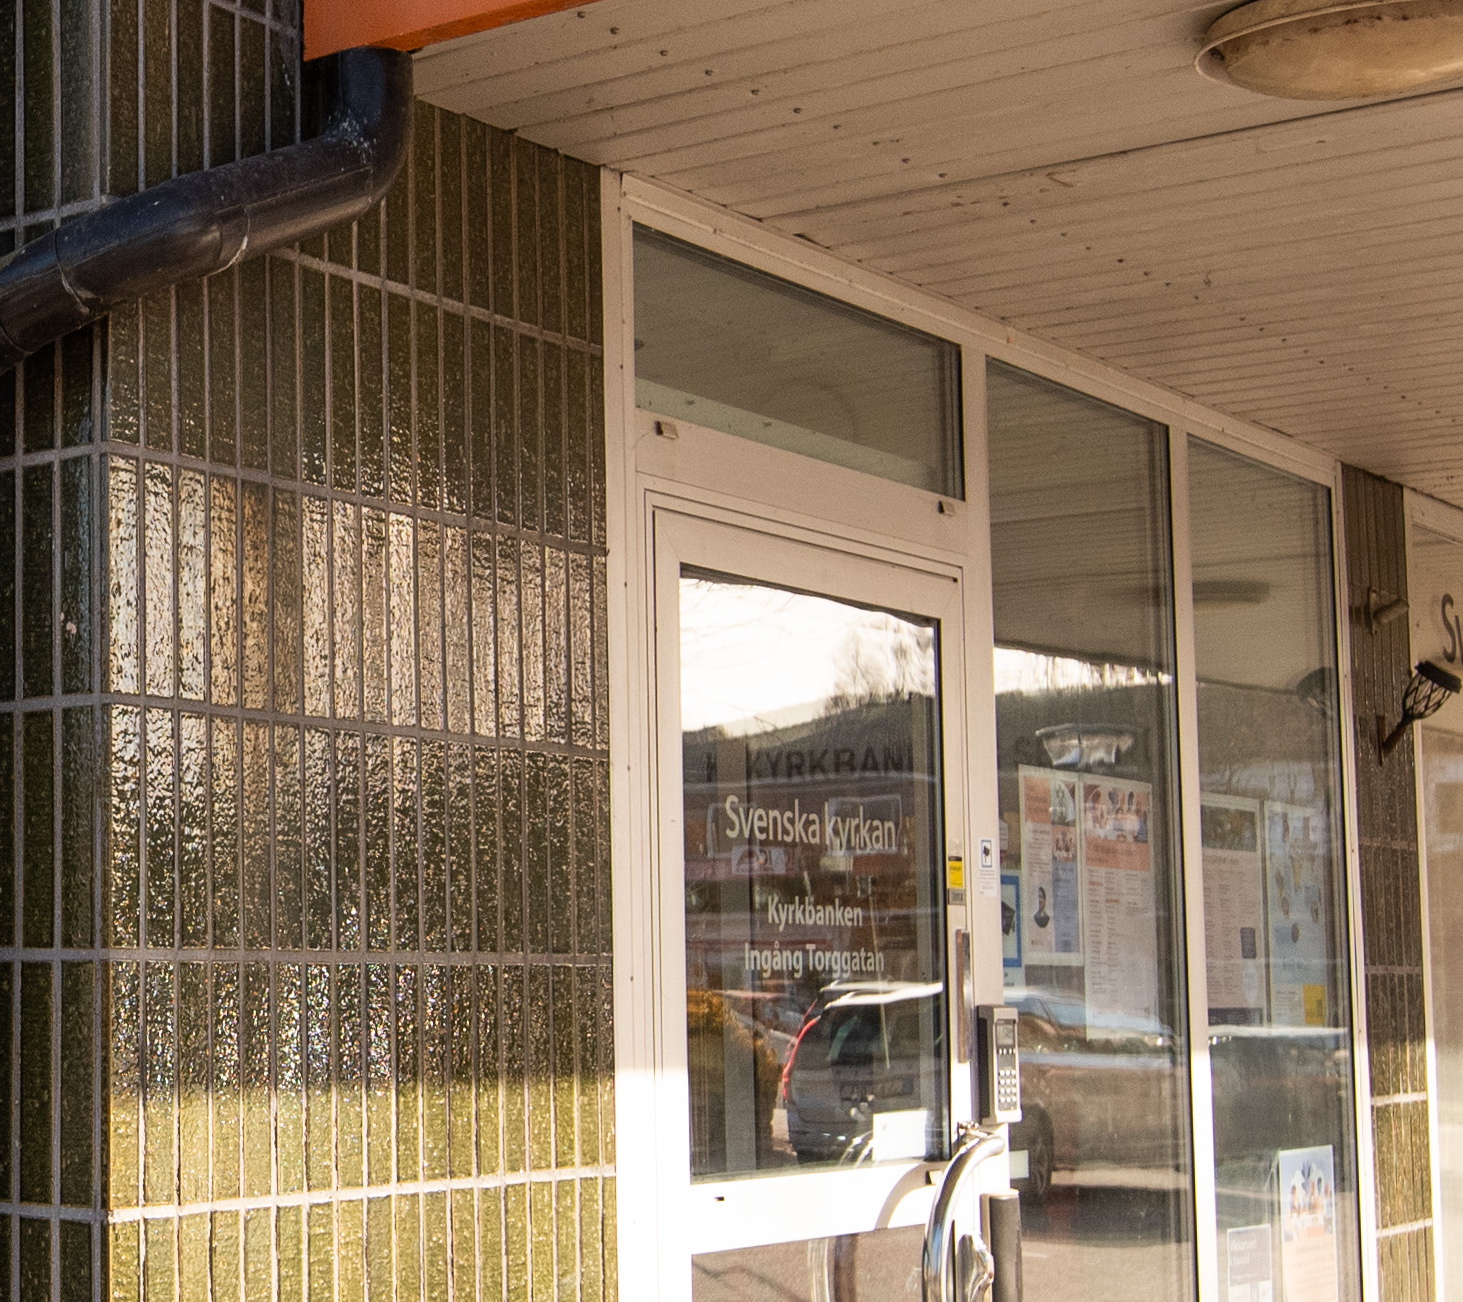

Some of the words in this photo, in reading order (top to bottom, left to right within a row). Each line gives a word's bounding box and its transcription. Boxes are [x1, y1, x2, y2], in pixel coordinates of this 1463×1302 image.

[724, 794, 821, 845] Svenska
[825, 800, 897, 853] kyrkan
[767, 895, 863, 932] Kyrkbanken
[744, 941, 804, 979] Ingång
[806, 943, 885, 979] Torggatan
